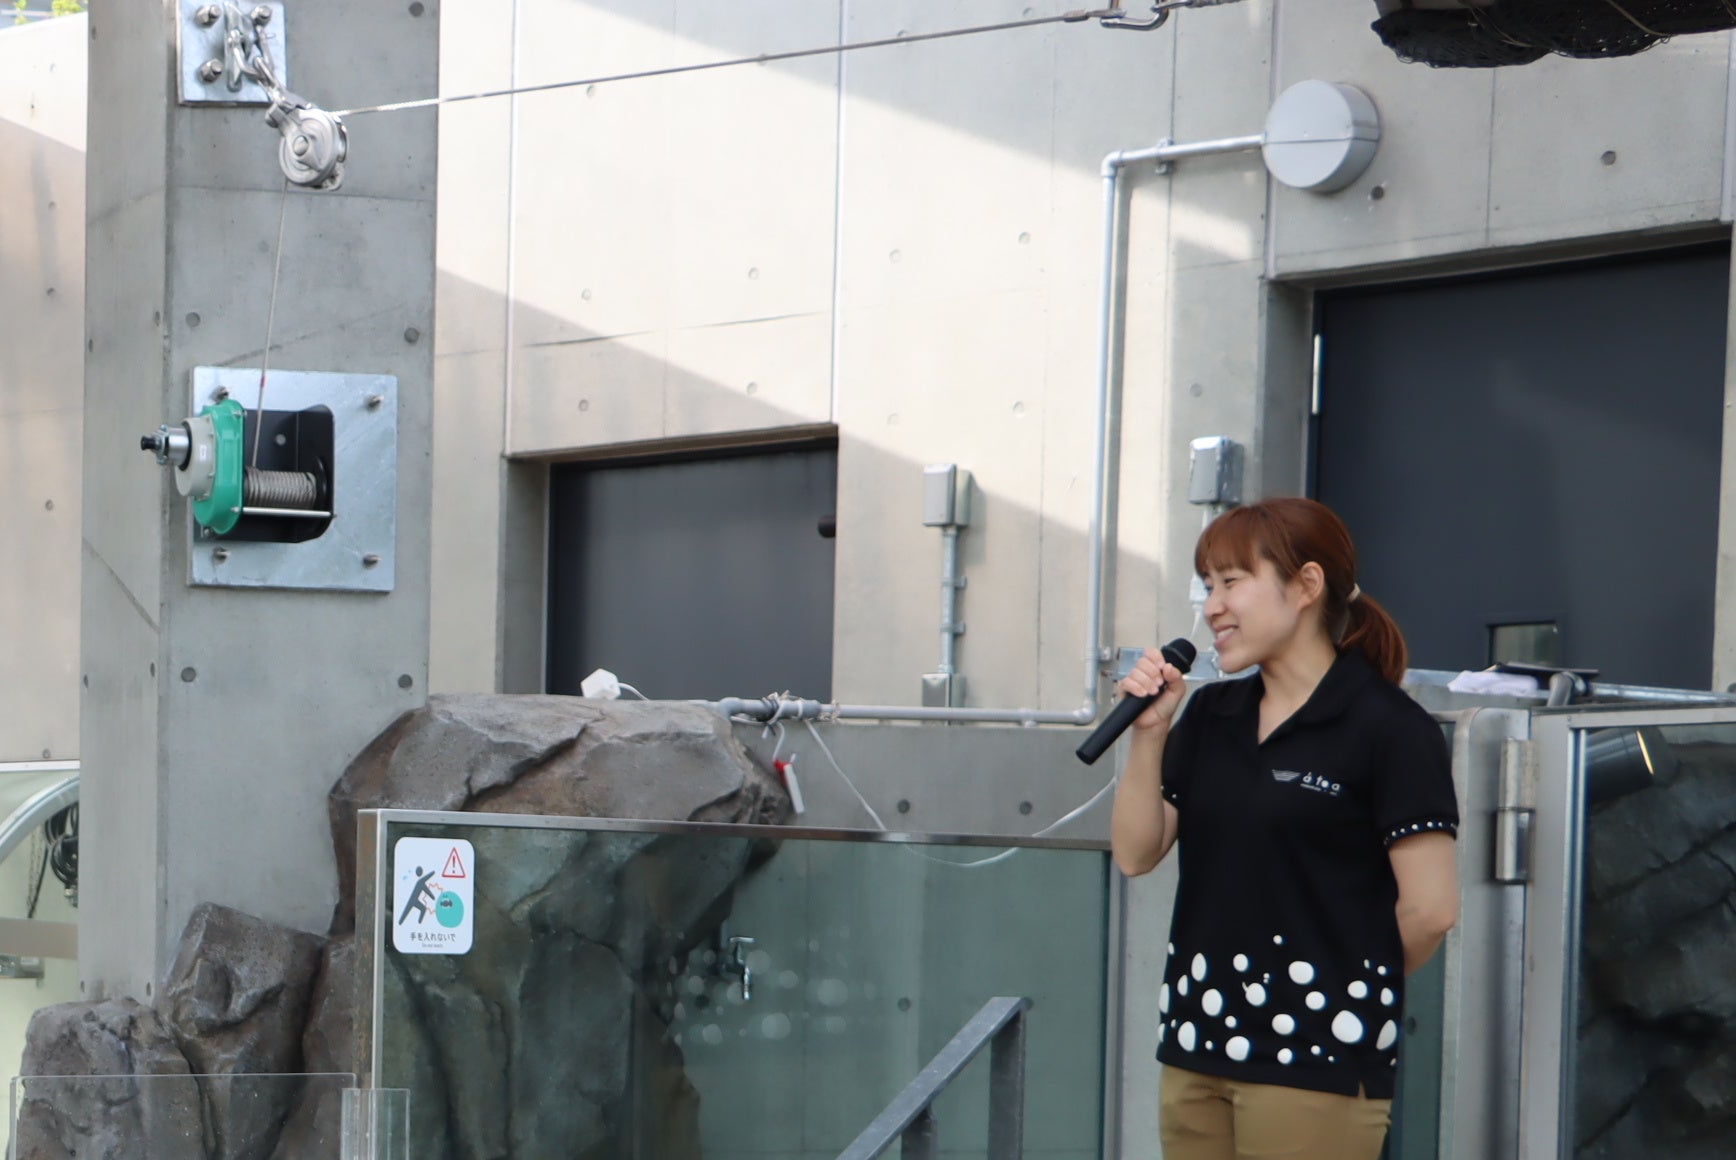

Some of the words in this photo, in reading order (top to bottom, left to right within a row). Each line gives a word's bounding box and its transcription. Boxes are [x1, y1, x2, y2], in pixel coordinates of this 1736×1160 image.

[410, 931, 456, 942] 手を入れないで
